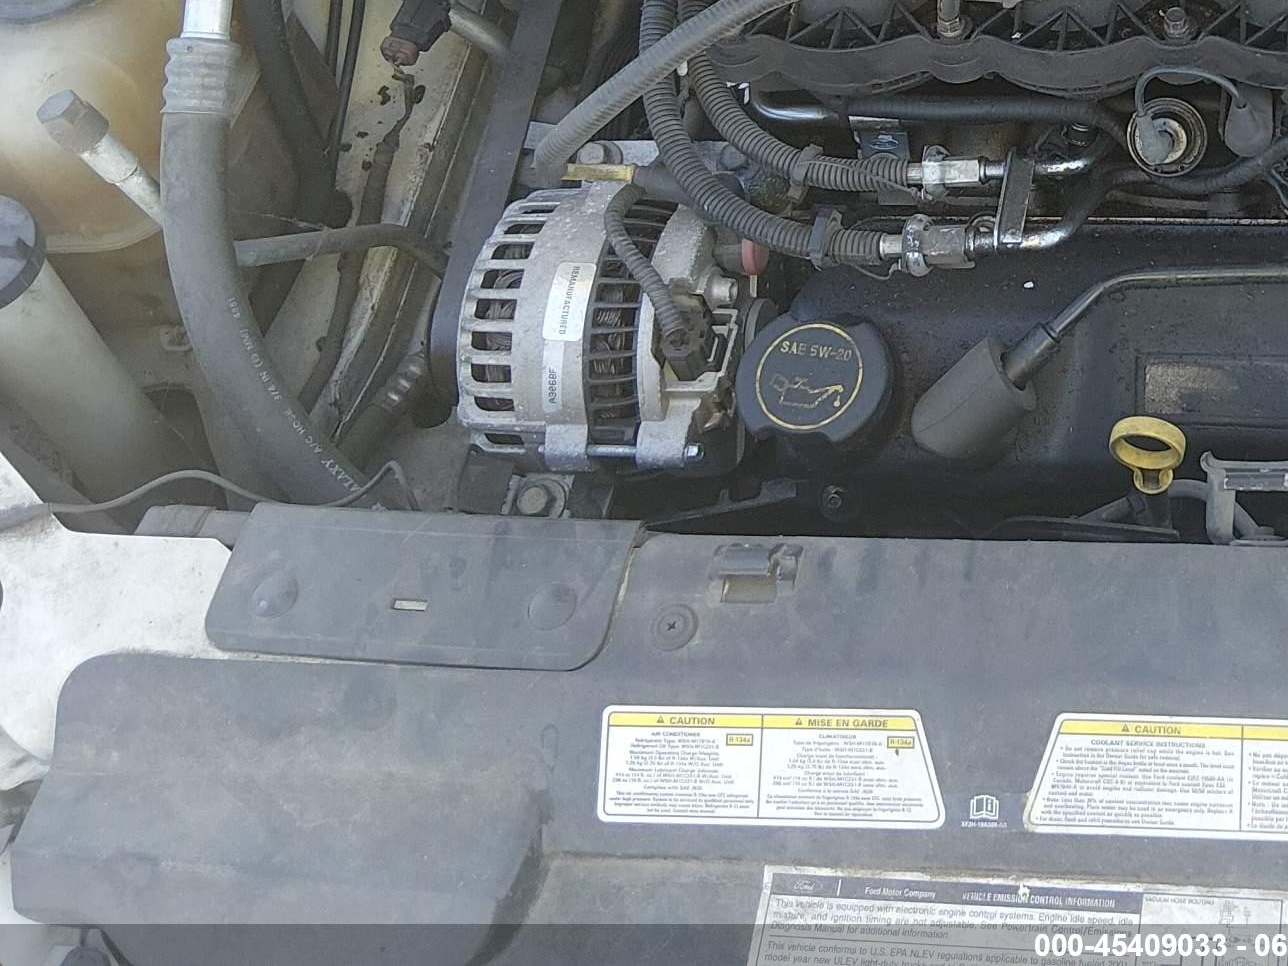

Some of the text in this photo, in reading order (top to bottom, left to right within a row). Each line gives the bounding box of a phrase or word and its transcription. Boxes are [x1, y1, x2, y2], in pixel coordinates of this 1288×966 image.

[558, 266, 581, 335] REMANUFACTURED
[780, 340, 852, 361] SAE 5W-20
[322, 459, 361, 491] ALAXY
[669, 716, 716, 725] CAUTION
[808, 719, 832, 727] MISE
[852, 720, 888, 728] GARDE
[1134, 725, 1182, 734] CAUTION
[864, 886, 936, 900] Ford Motor Company
[962, 892, 1116, 908] VEHICLE EMISSION CONTROL INFORMATION
[776, 898, 794, 908] This
[796, 900, 824, 909] vehicle
[826, 900, 834, 910] is
[836, 902, 874, 914] equipped
[877, 902, 894, 913] with
[896, 904, 936, 914] electronic
[938, 908, 966, 918] engine
[969, 908, 997, 919] control
[1038, 912, 1068, 923] Engine
[1070, 914, 1084, 923] idle
[1118, 916, 1134, 926] idle
[770, 921, 950, 938] Diagnosis Manual for additional information.
[773, 912, 807, 921] mixture,
[811, 912, 828, 920] and
[830, 914, 862, 924] ignition
[866, 915, 892, 926] timing
[913, 917, 928, 926] not
[930, 919, 976, 930] adjustable.
[980, 920, 998, 930] See
[764, 954, 790, 962] model
[793, 956, 810, 965] year
[834, 956, 858, 966] ULEV
[768, 941, 784, 950] This
[788, 942, 816, 952] vehicle
[818, 944, 856, 954] conforms
[860, 946, 867, 954] to
[890, 948, 906, 956] EPA
[910, 948, 936, 958] NLEV
[937, 951, 982, 962] regulations
[986, 953, 1028, 964] applicable
[1030, 955, 1038, 964] to
[1041, 956, 1078, 966] gasoline
